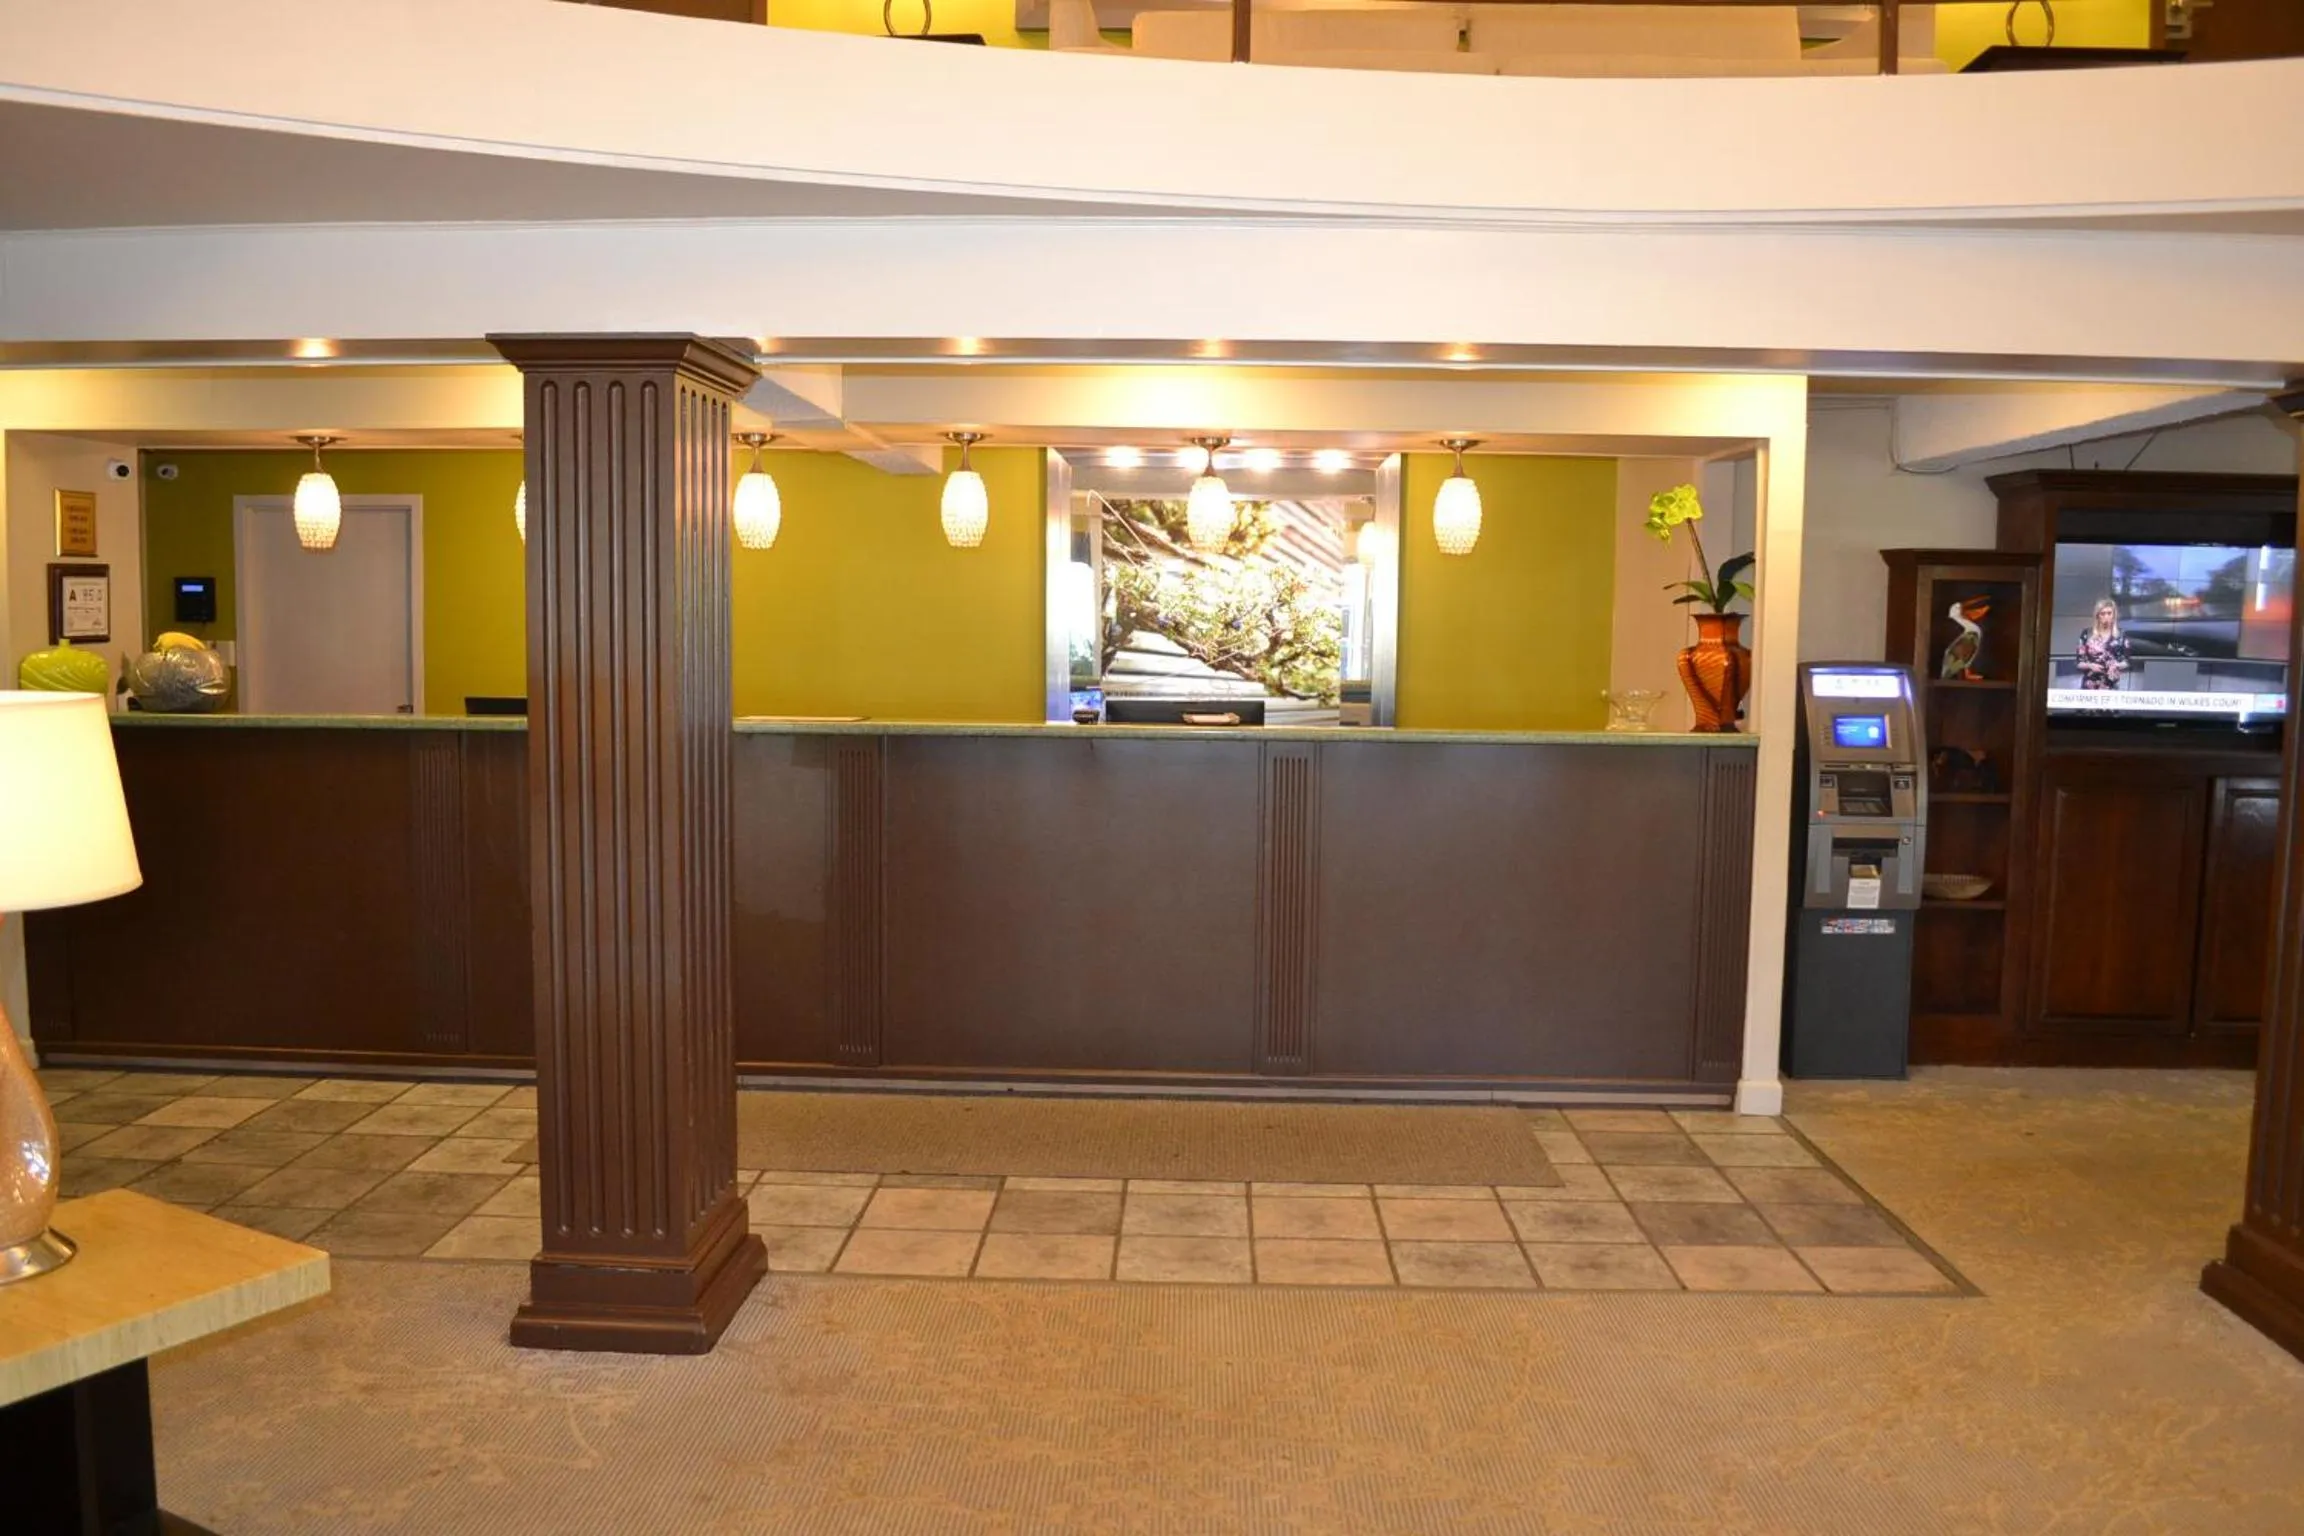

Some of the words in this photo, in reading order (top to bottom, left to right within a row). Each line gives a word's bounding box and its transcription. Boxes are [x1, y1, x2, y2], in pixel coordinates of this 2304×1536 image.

[69, 589, 77, 601] A
[2051, 694, 2098, 704] CONFIRMS
[2121, 694, 2165, 706] TORNADO
[2167, 696, 2176, 706] IN
[2178, 696, 2210, 707] WILKES
